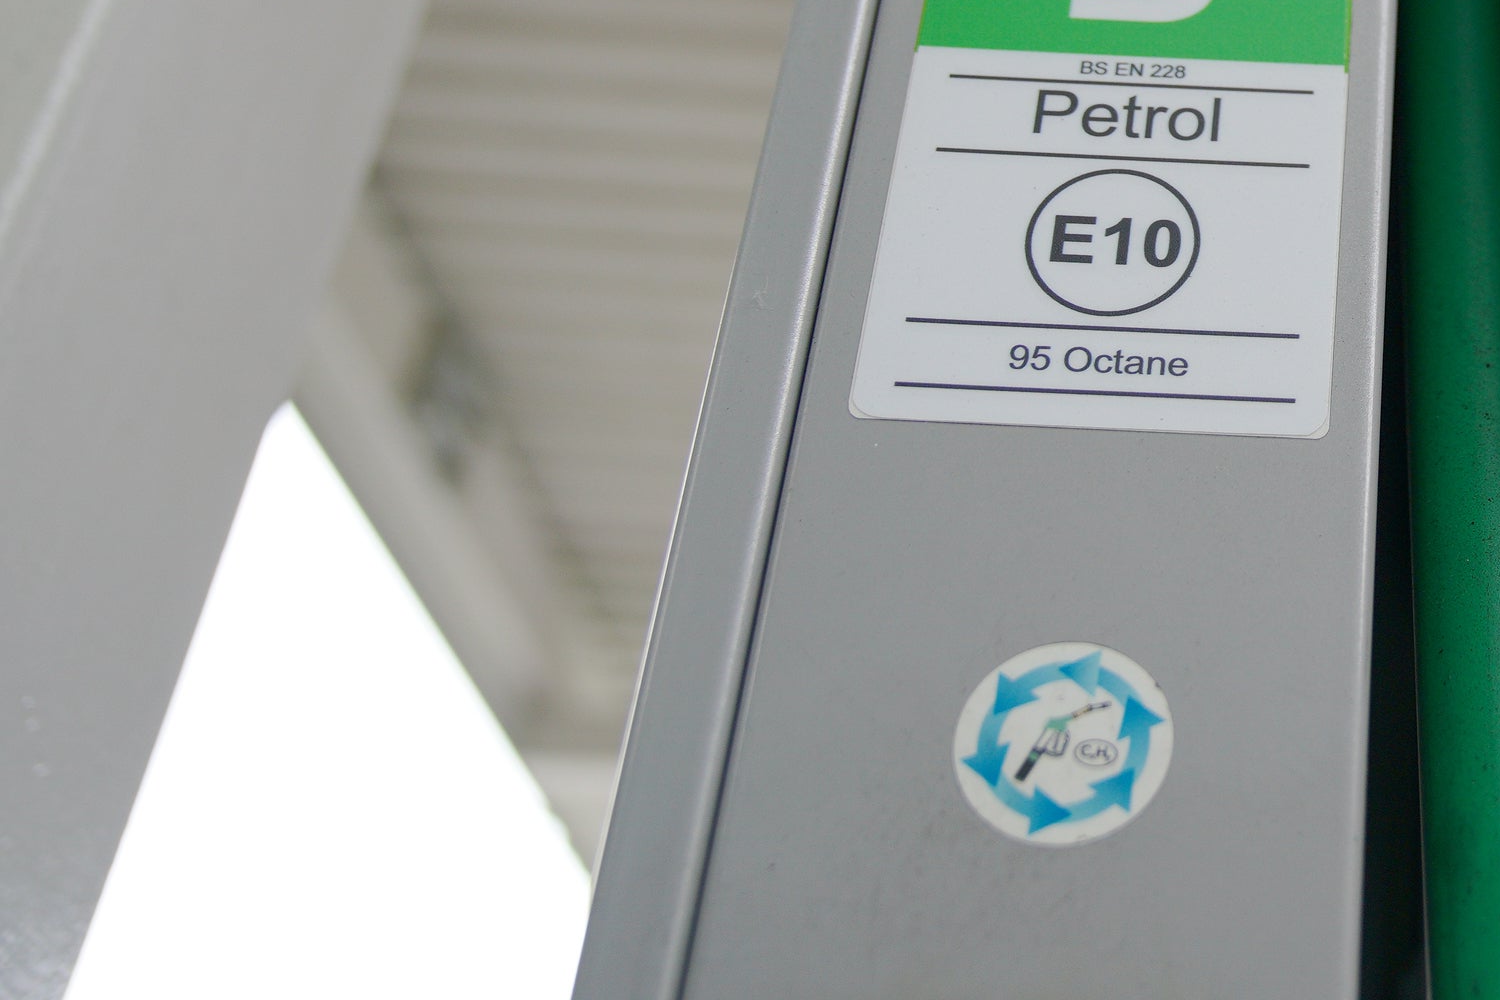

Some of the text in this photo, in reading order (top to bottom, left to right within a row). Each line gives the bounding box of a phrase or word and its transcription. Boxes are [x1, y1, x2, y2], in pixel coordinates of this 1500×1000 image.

[1079, 60, 1187, 79] BS EN 228
[1031, 89, 1222, 142] Petrol
[1048, 214, 1182, 268] E10
[1008, 344, 1189, 377] 95 Octane
